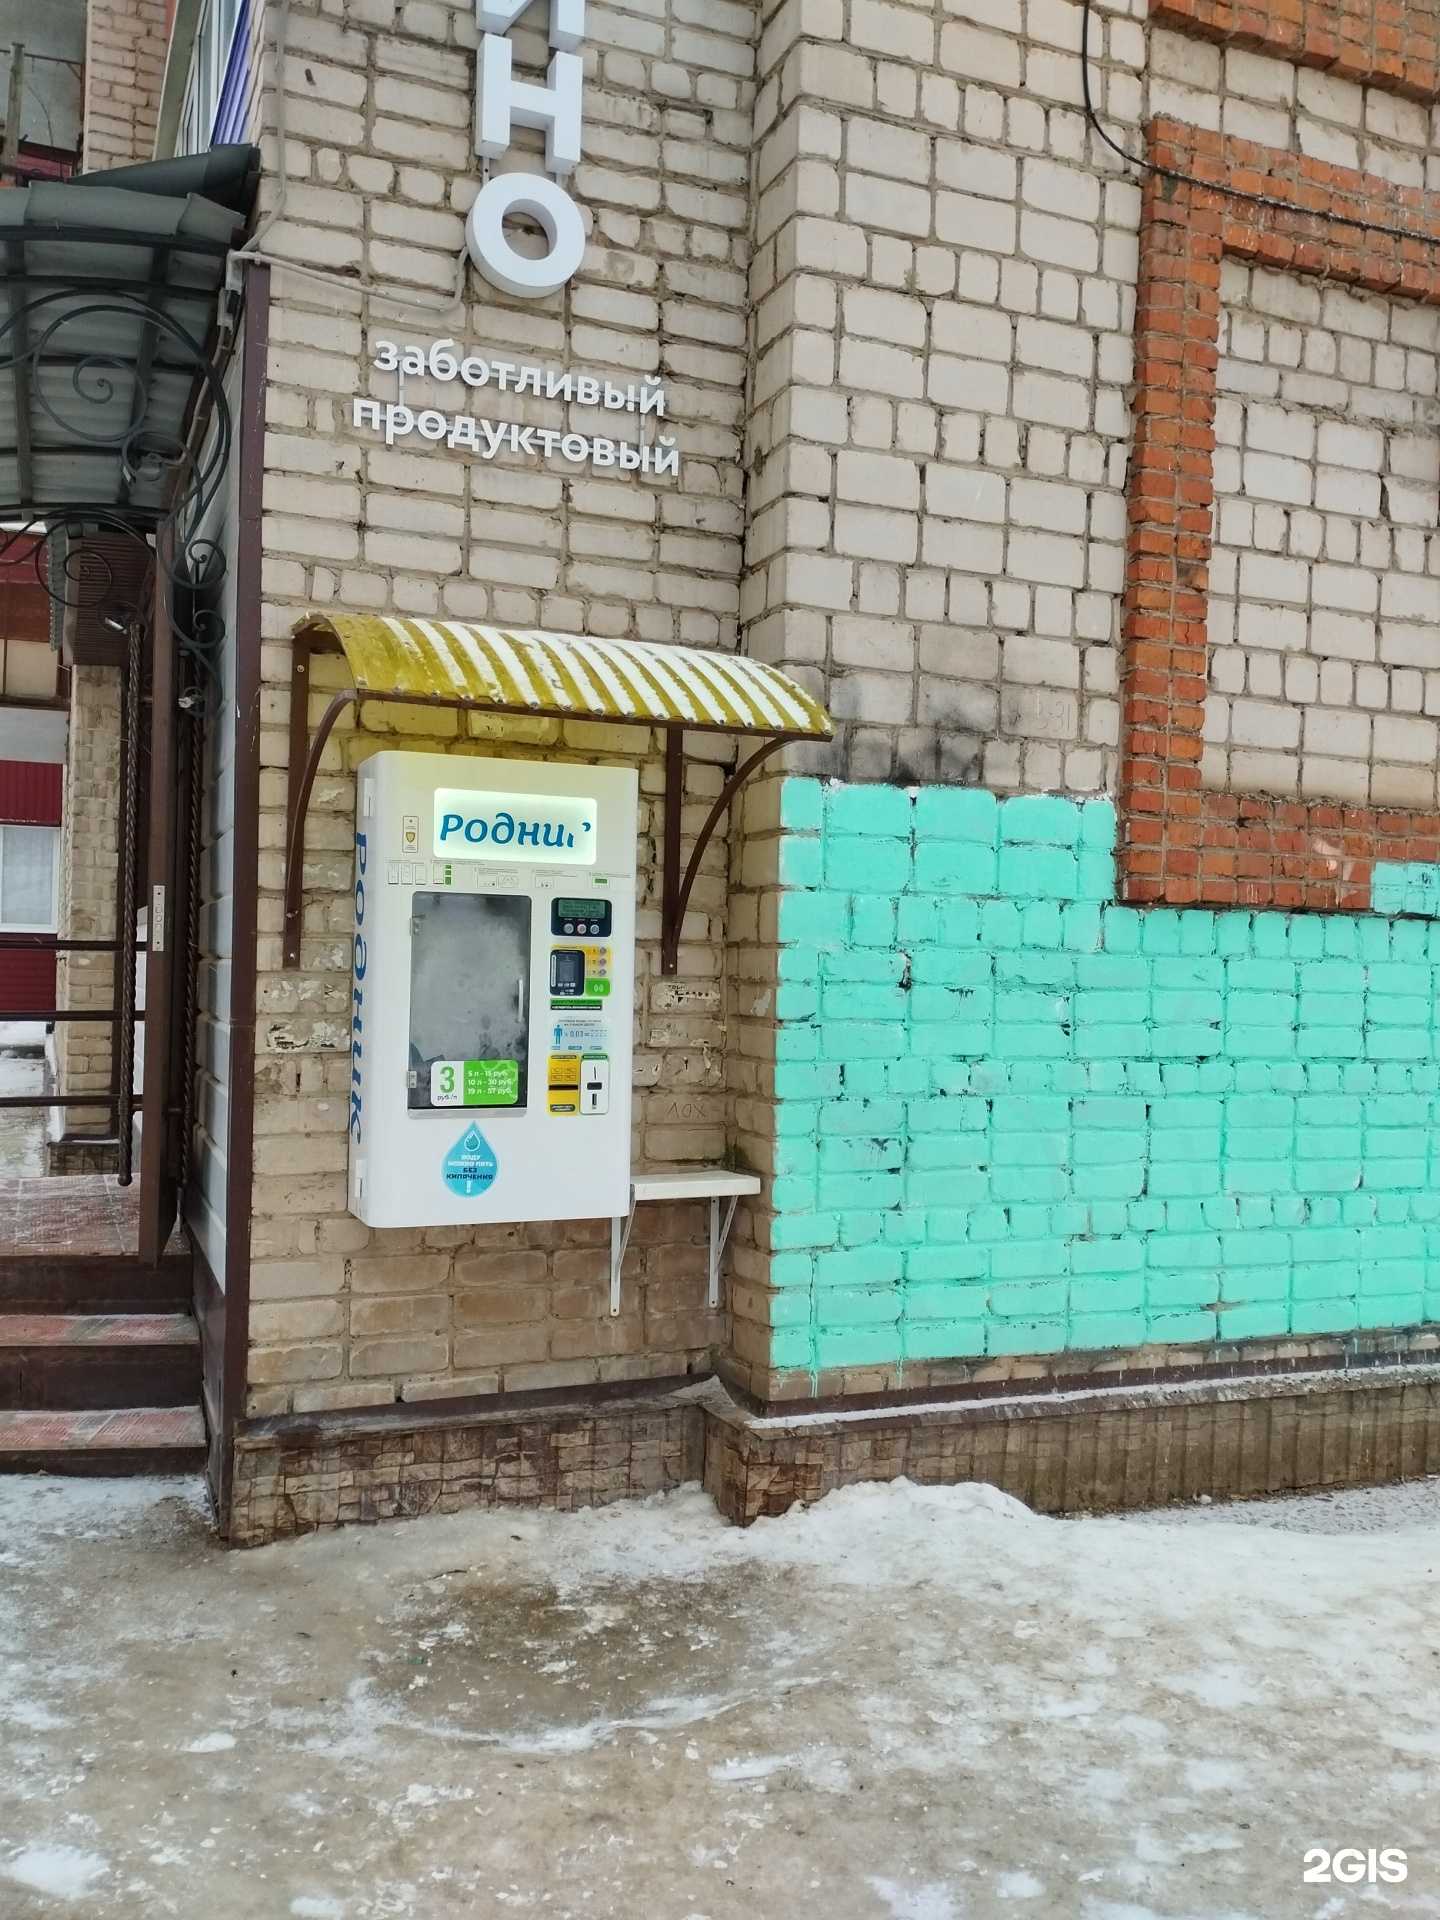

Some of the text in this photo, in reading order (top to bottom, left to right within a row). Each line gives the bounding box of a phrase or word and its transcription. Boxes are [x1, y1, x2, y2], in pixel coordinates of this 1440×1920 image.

[373, 338, 666, 417] заботливый
[353, 397, 679, 477] продуктовый
[440, 1066, 455, 1093] 3
